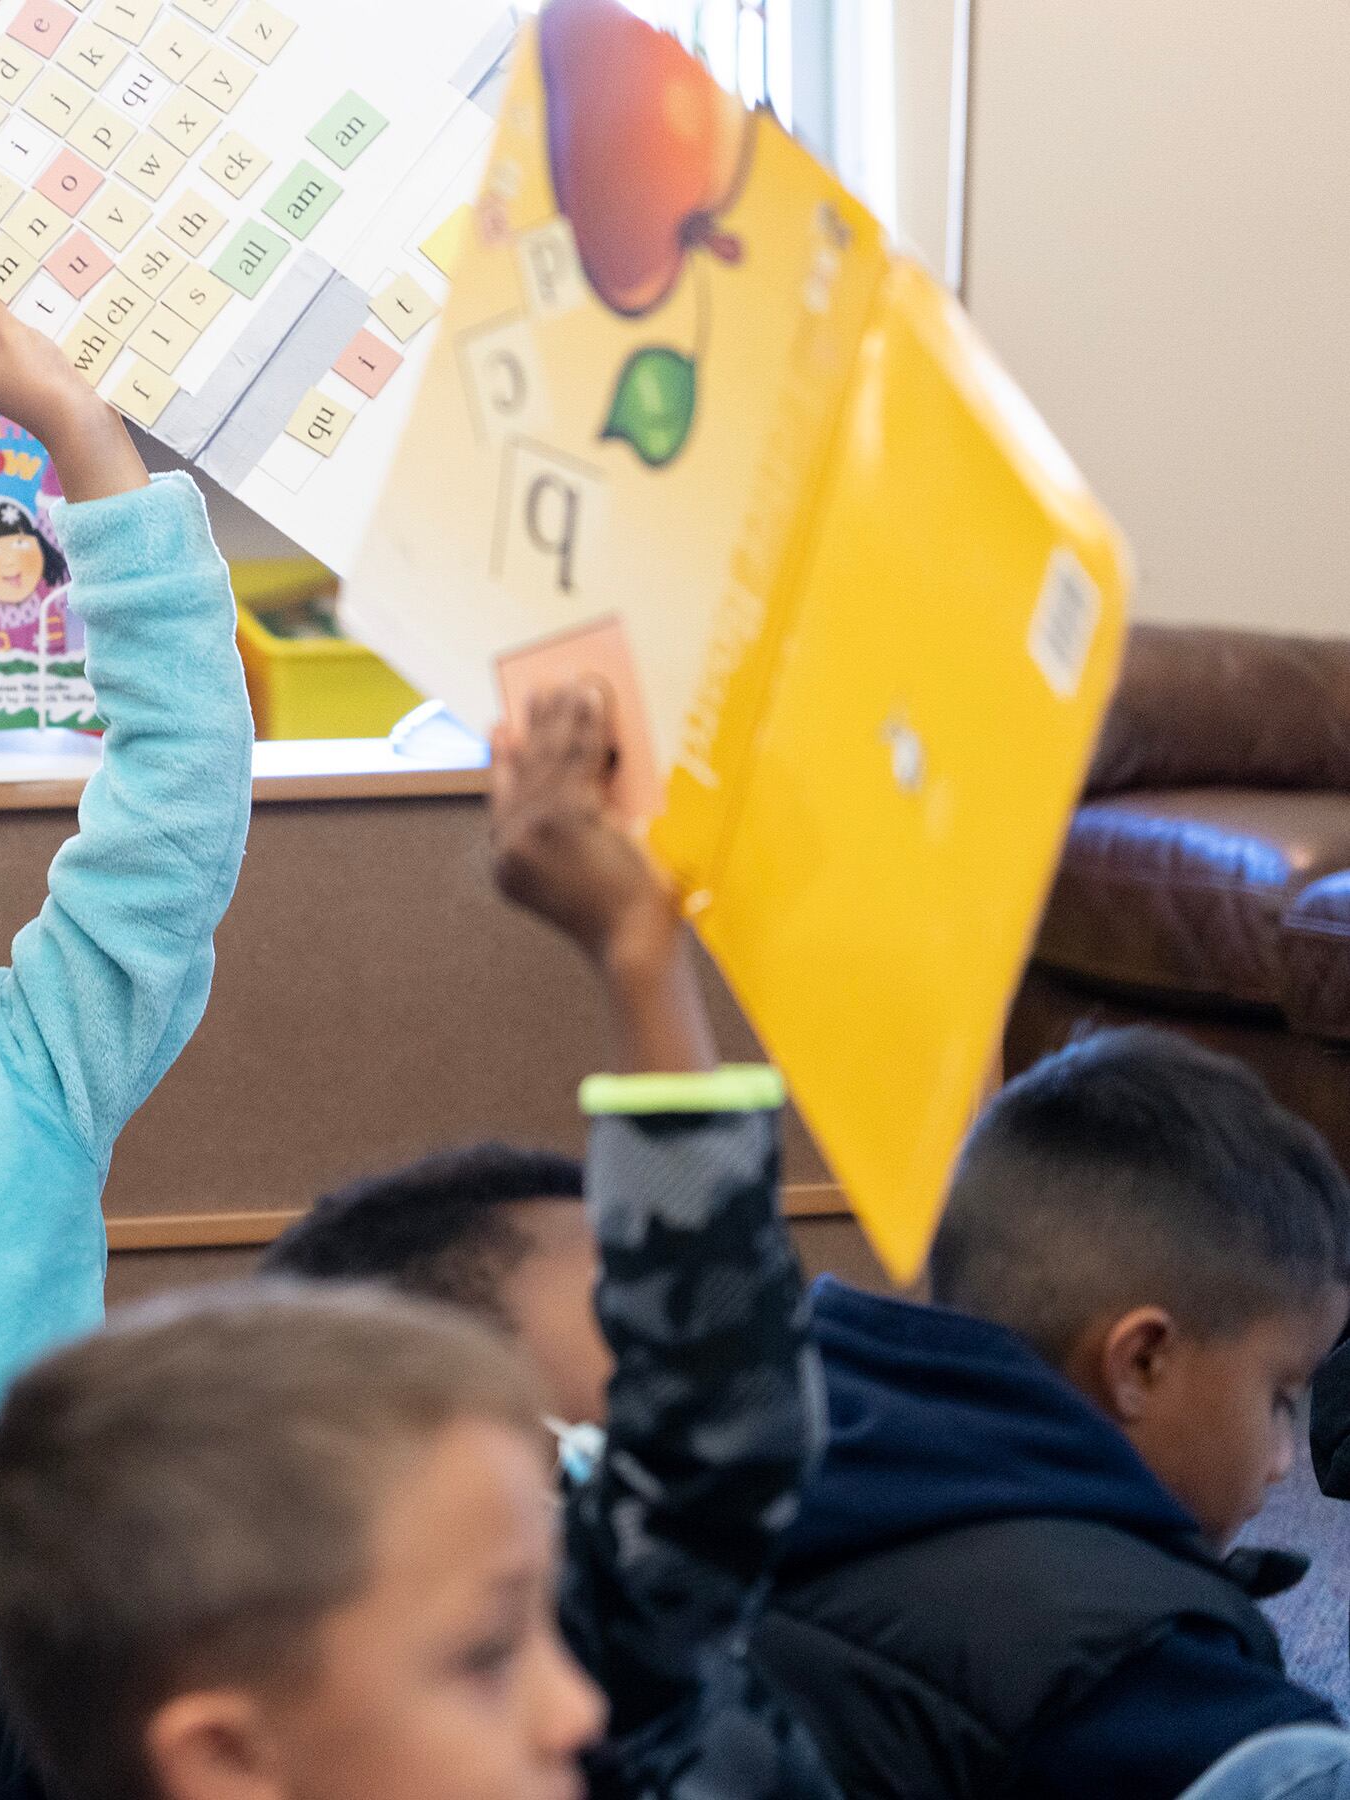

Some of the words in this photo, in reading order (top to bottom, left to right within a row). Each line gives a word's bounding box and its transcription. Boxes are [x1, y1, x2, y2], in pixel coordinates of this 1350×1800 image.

[0, 57, 20, 80] d
[33, 18, 51, 34] e
[10, 140, 29, 156] i
[50, 93, 72, 115] j
[78, 47, 105, 68] k
[28, 217, 48, 237] n
[60, 174, 78, 192] o
[92, 127, 112, 151] p
[121, 73, 153, 107] qu
[169, 41, 183, 59] r
[35, 300, 54, 314] t
[68, 255, 89, 275] u
[107, 207, 124, 224] v
[139, 153, 161, 176] w
[176, 113, 198, 135] x
[212, 69, 233, 94] y
[254, 22, 273, 41] z
[238, 239, 268, 276] all
[286, 180, 324, 220] am
[335, 116, 367, 148] an
[73, 332, 107, 373] wh
[105, 294, 136, 326] ch
[141, 249, 171, 281] sh
[181, 210, 209, 239] th
[223, 151, 253, 182] ck
[189, 288, 207, 306] s
[306, 406, 336, 441] qu
[357, 355, 376, 372] i
[396, 298, 412, 314] t
